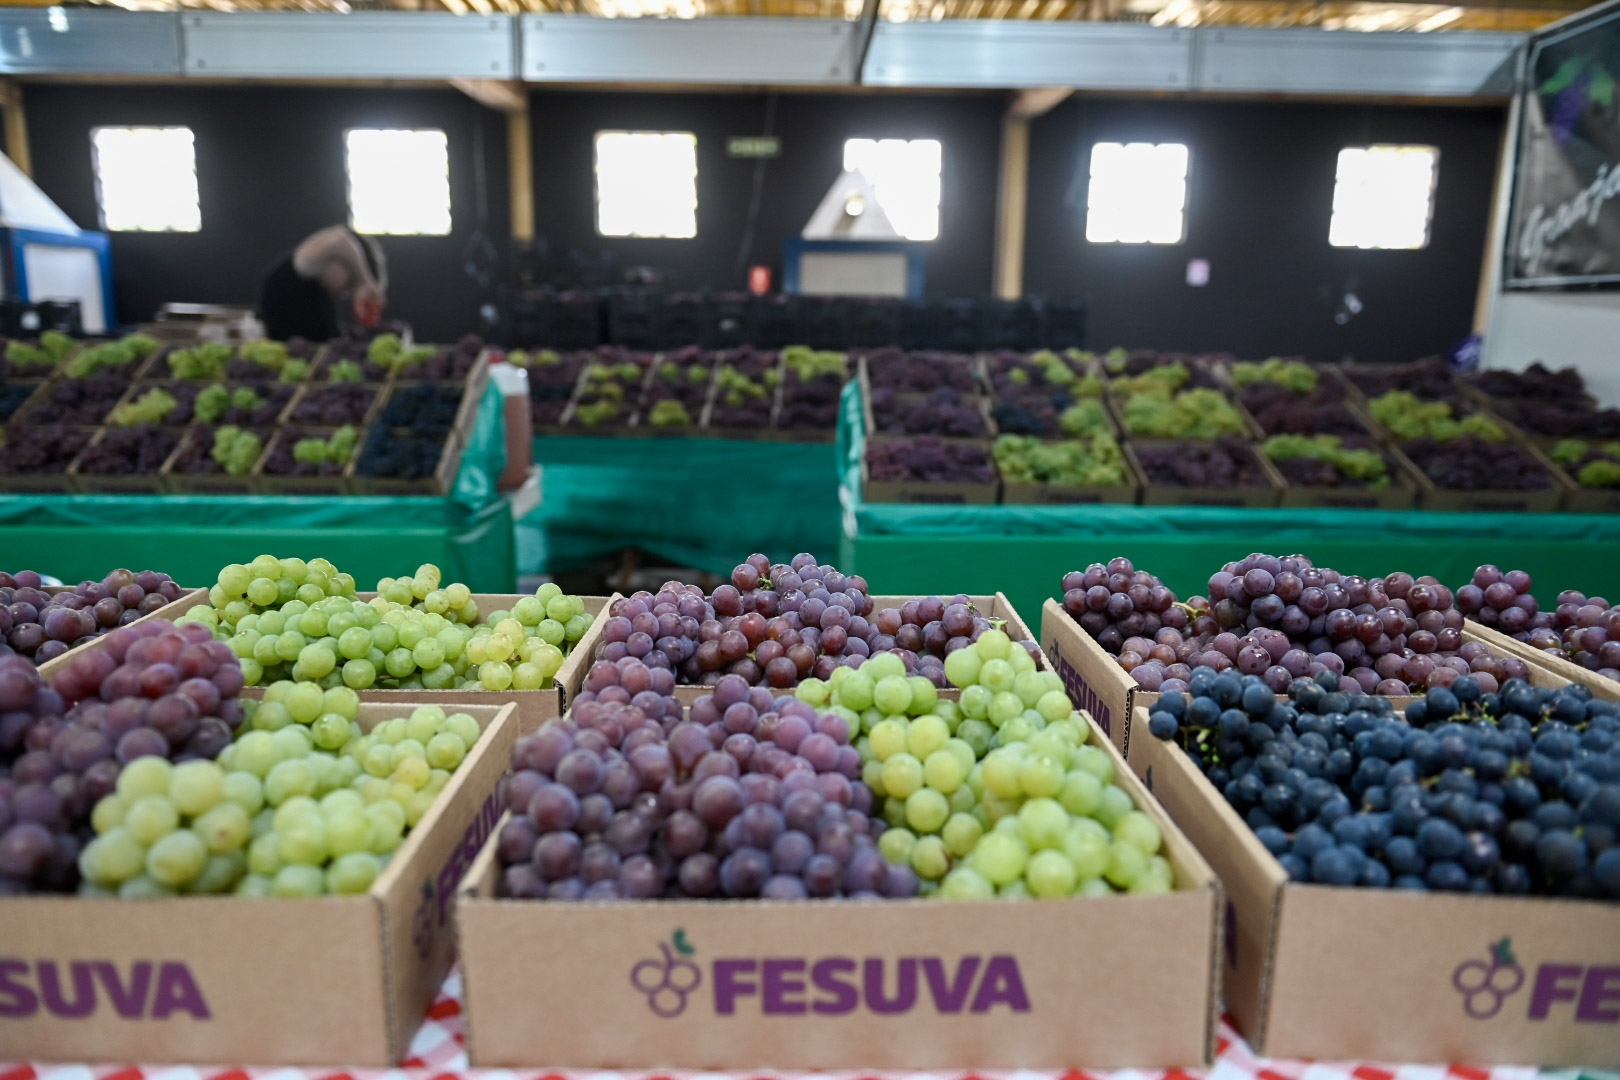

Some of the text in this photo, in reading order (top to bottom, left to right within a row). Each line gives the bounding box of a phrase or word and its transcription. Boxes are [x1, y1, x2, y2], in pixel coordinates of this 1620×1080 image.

[1060, 656, 1111, 738] FESUVA
[438, 771, 508, 928] FESUV
[0, 958, 212, 1020] SUVA
[713, 955, 1031, 1016] FESUVA
[1527, 963, 1620, 1022] FE
